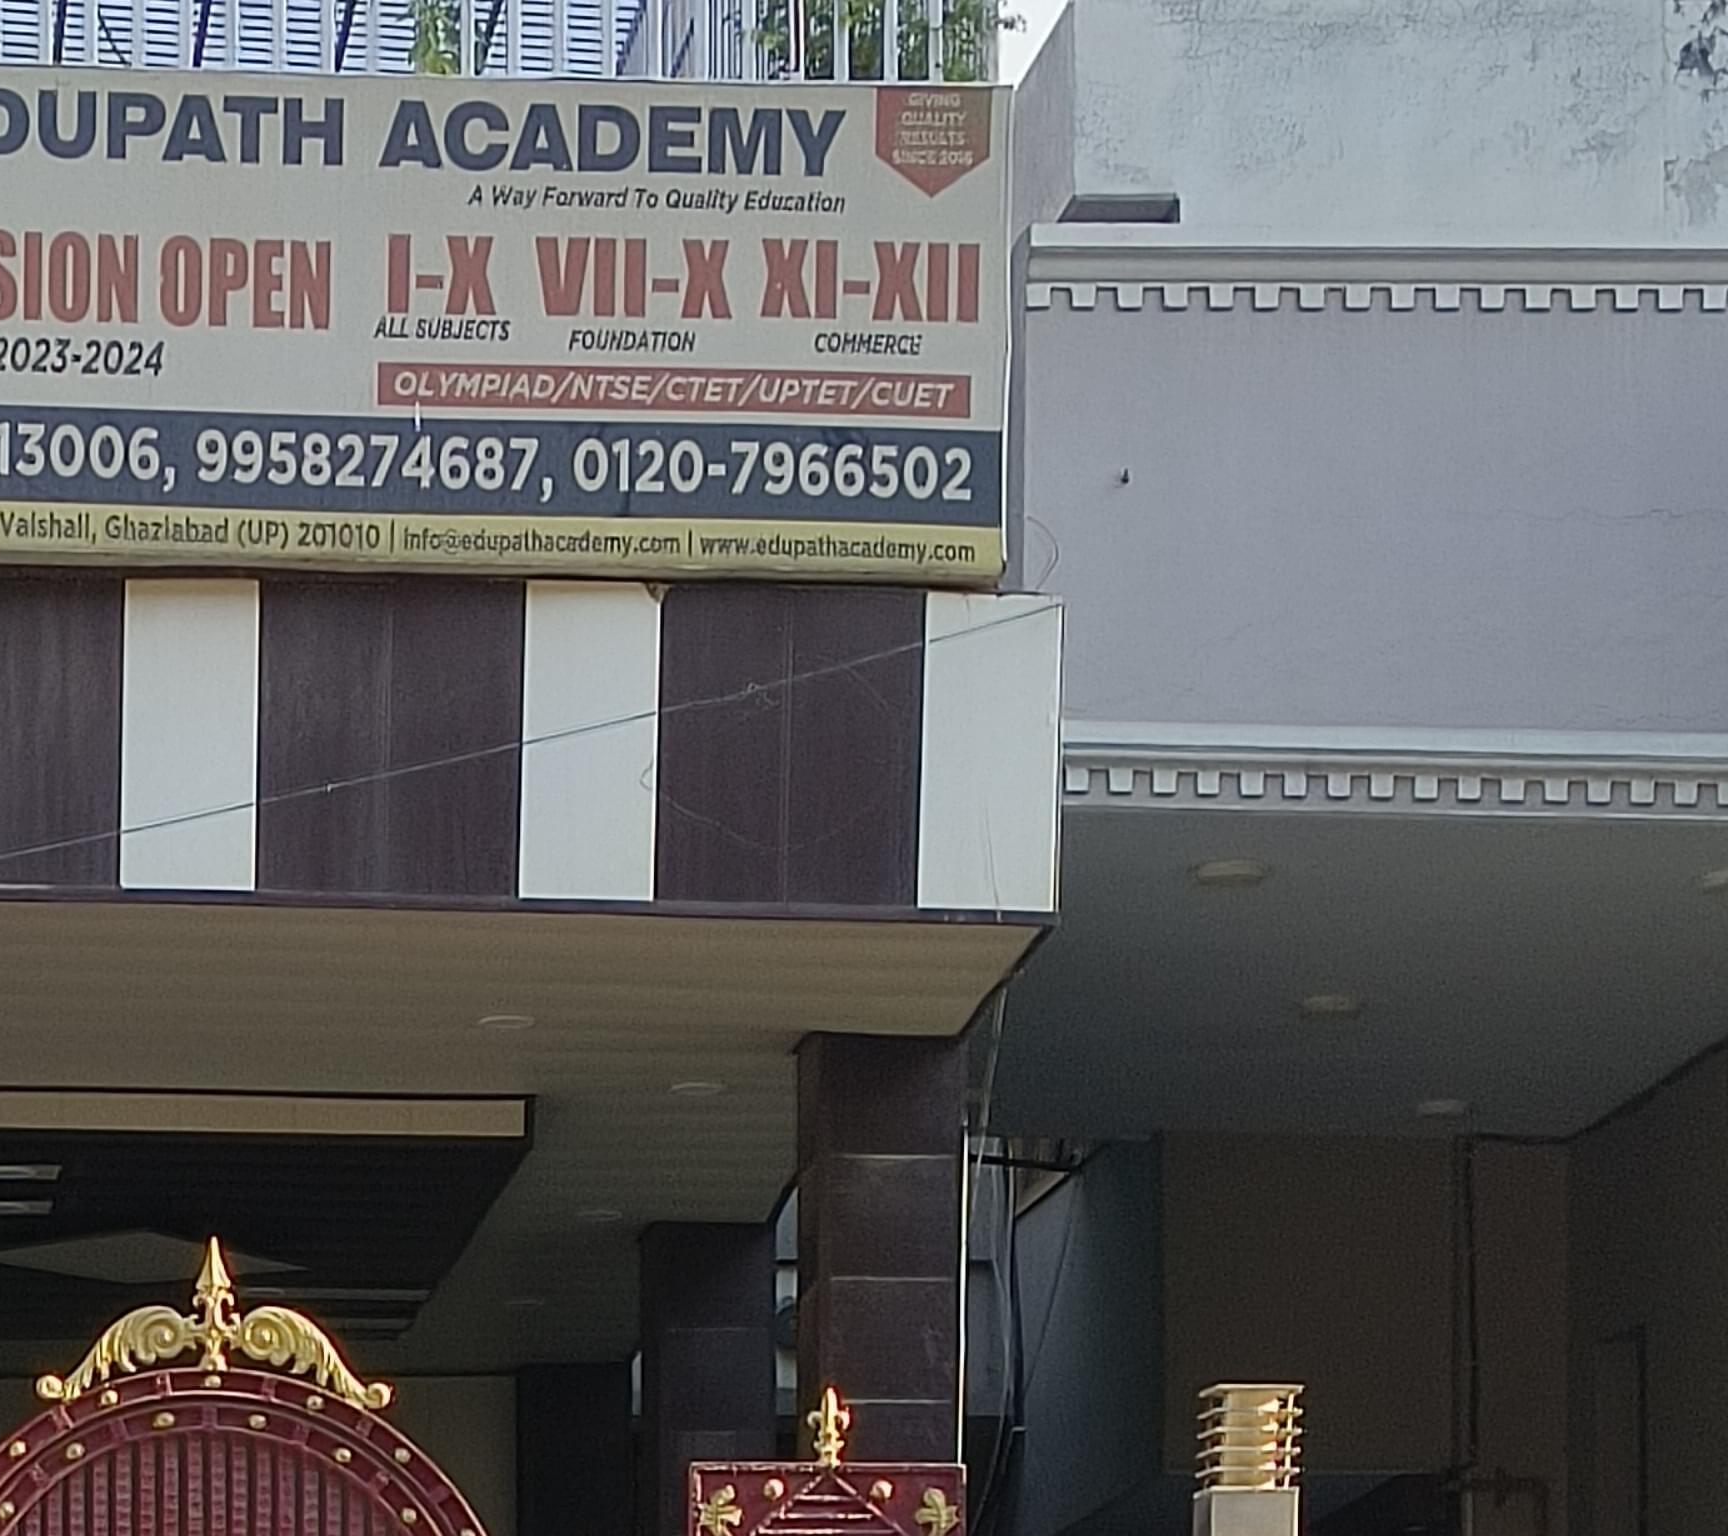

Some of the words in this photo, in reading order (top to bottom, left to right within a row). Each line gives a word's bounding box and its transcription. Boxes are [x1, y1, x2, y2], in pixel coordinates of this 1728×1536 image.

[378, 99, 847, 177] ACADEMY
[468, 186, 483, 206] A
[492, 186, 537, 209] Way
[542, 186, 629, 208] Forward
[634, 188, 659, 208] To
[665, 189, 738, 214] Quality
[743, 190, 846, 214] Education
[159, 236, 332, 331] OPEN
[386, 233, 496, 315] I-X
[535, 236, 732, 320] VII-X
[761, 238, 980, 323] XI-XII
[373, 316, 409, 339] ALL
[416, 318, 511, 341] SUBJECTS
[569, 329, 696, 352] FOUNDATION
[813, 332, 922, 356] COMMERCE
[393, 370, 955, 409] OLYMPIAD/NTSE/CTET/UPTET/CUET
[196, 429, 553, 502] 9958274687,
[573, 437, 971, 500] 0120-7966502
[105, 514, 228, 543] Ghaziabad
[237, 519, 289, 549] (UP)
[297, 523, 381, 550] 201010
[700, 534, 976, 564] www.edupathacademy.com
